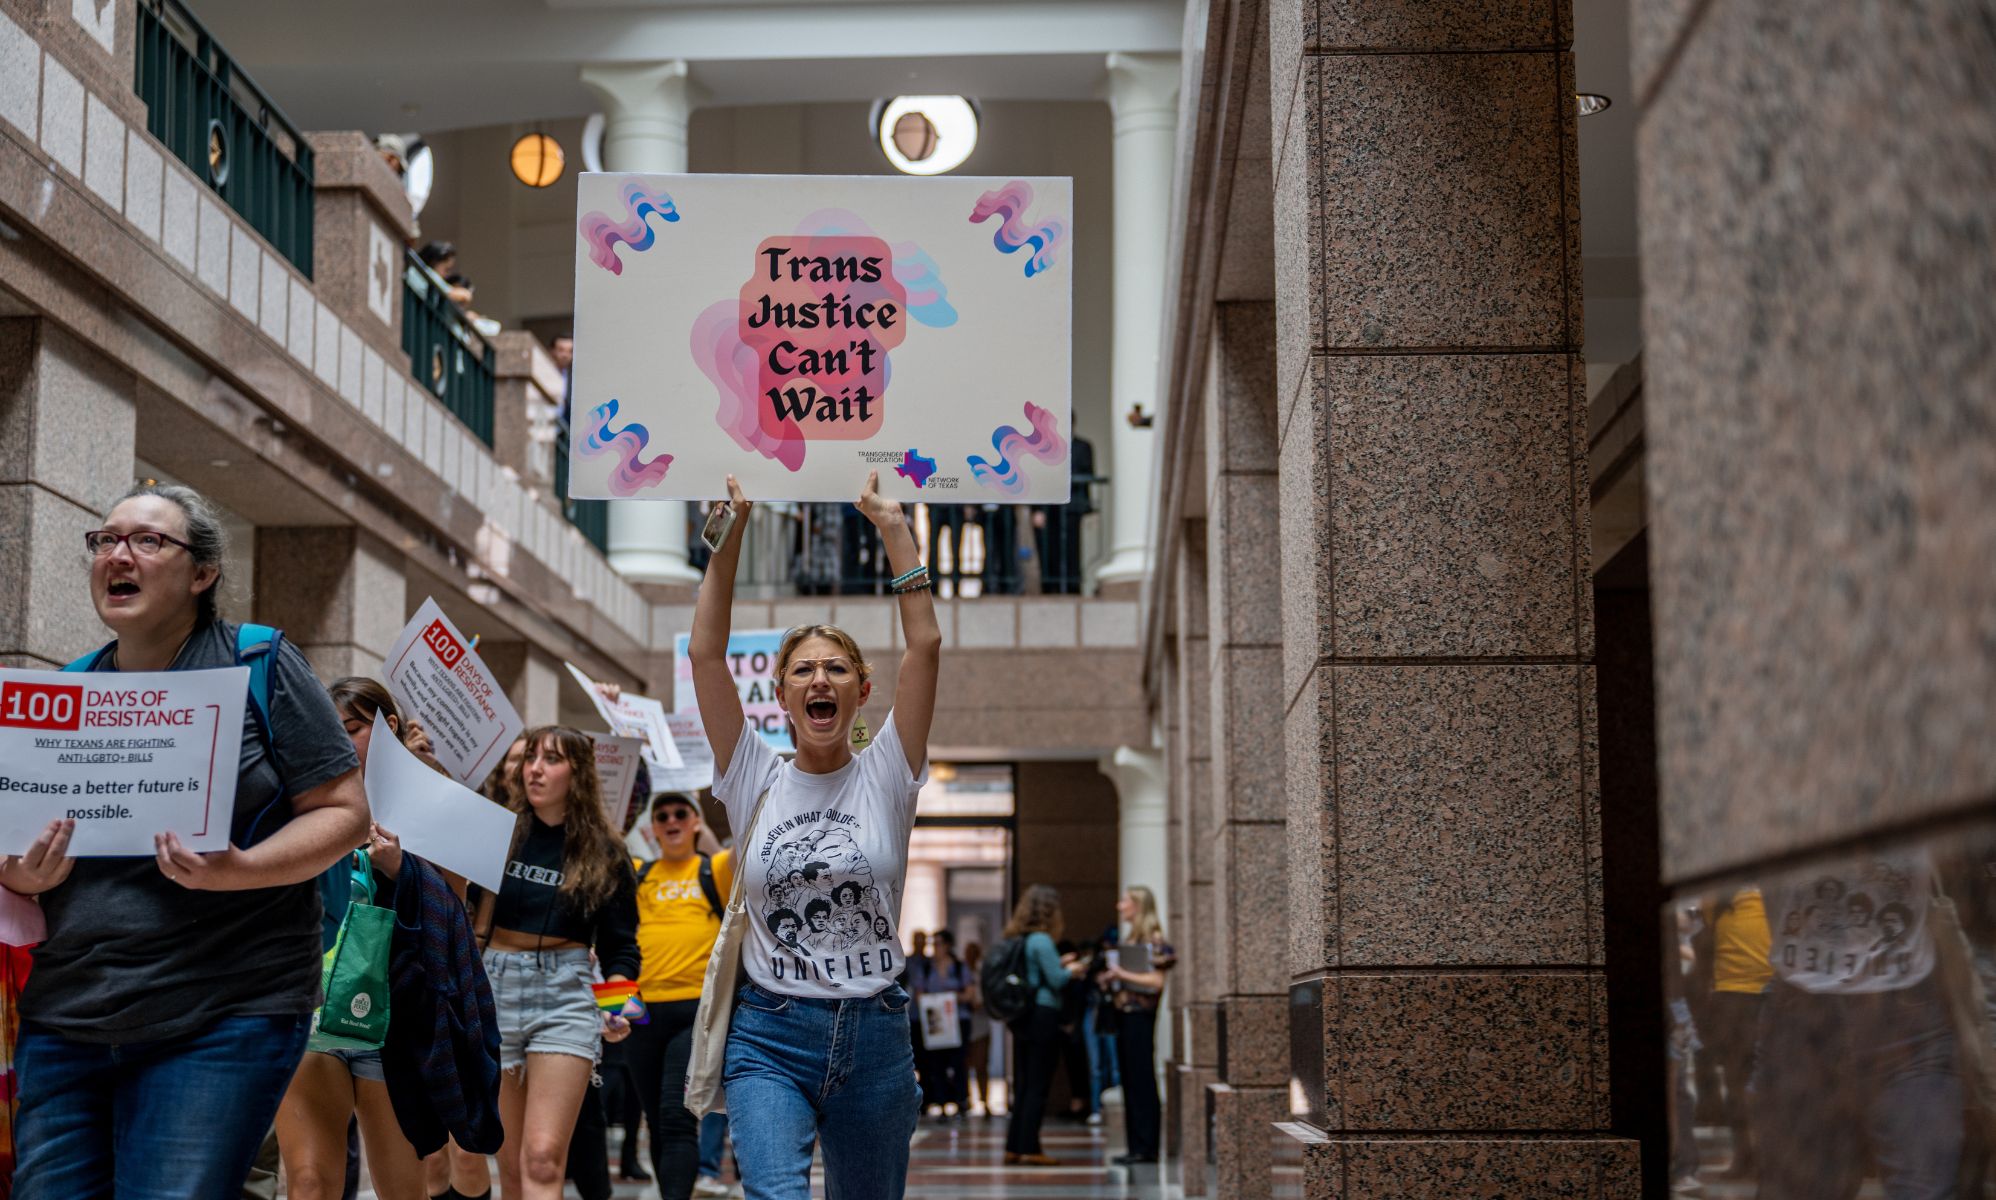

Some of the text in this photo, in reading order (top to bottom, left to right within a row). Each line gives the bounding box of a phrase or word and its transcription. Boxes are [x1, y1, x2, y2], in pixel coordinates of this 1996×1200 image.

[761, 247, 884, 283] Trans
[748, 292, 897, 330] Justice
[768, 339, 877, 376] Can't
[765, 385, 875, 422] Wait
[426, 627, 459, 662] 100
[454, 665, 497, 721] RESISTANCE
[460, 656, 494, 697] DAYS OF
[6, 690, 74, 723] 100
[86, 690, 169, 707] DAYS OF
[410, 660, 428, 690] Because
[436, 696, 466, 732] community
[84, 709, 196, 727] RESISTANCE
[434, 710, 449, 728] fight
[35, 737, 175, 748] WHY TEXANS ARE FIGHTING
[58, 752, 153, 763] ANTI-LGBTQ+ BILLS
[0, 776, 200, 795] Because a better future is
[66, 804, 133, 820] possible.
[761, 824, 786, 857] BELIEVE
[783, 819, 795, 831] IN
[794, 811, 821, 827] WHAT
[772, 949, 893, 980] UNIFIED
